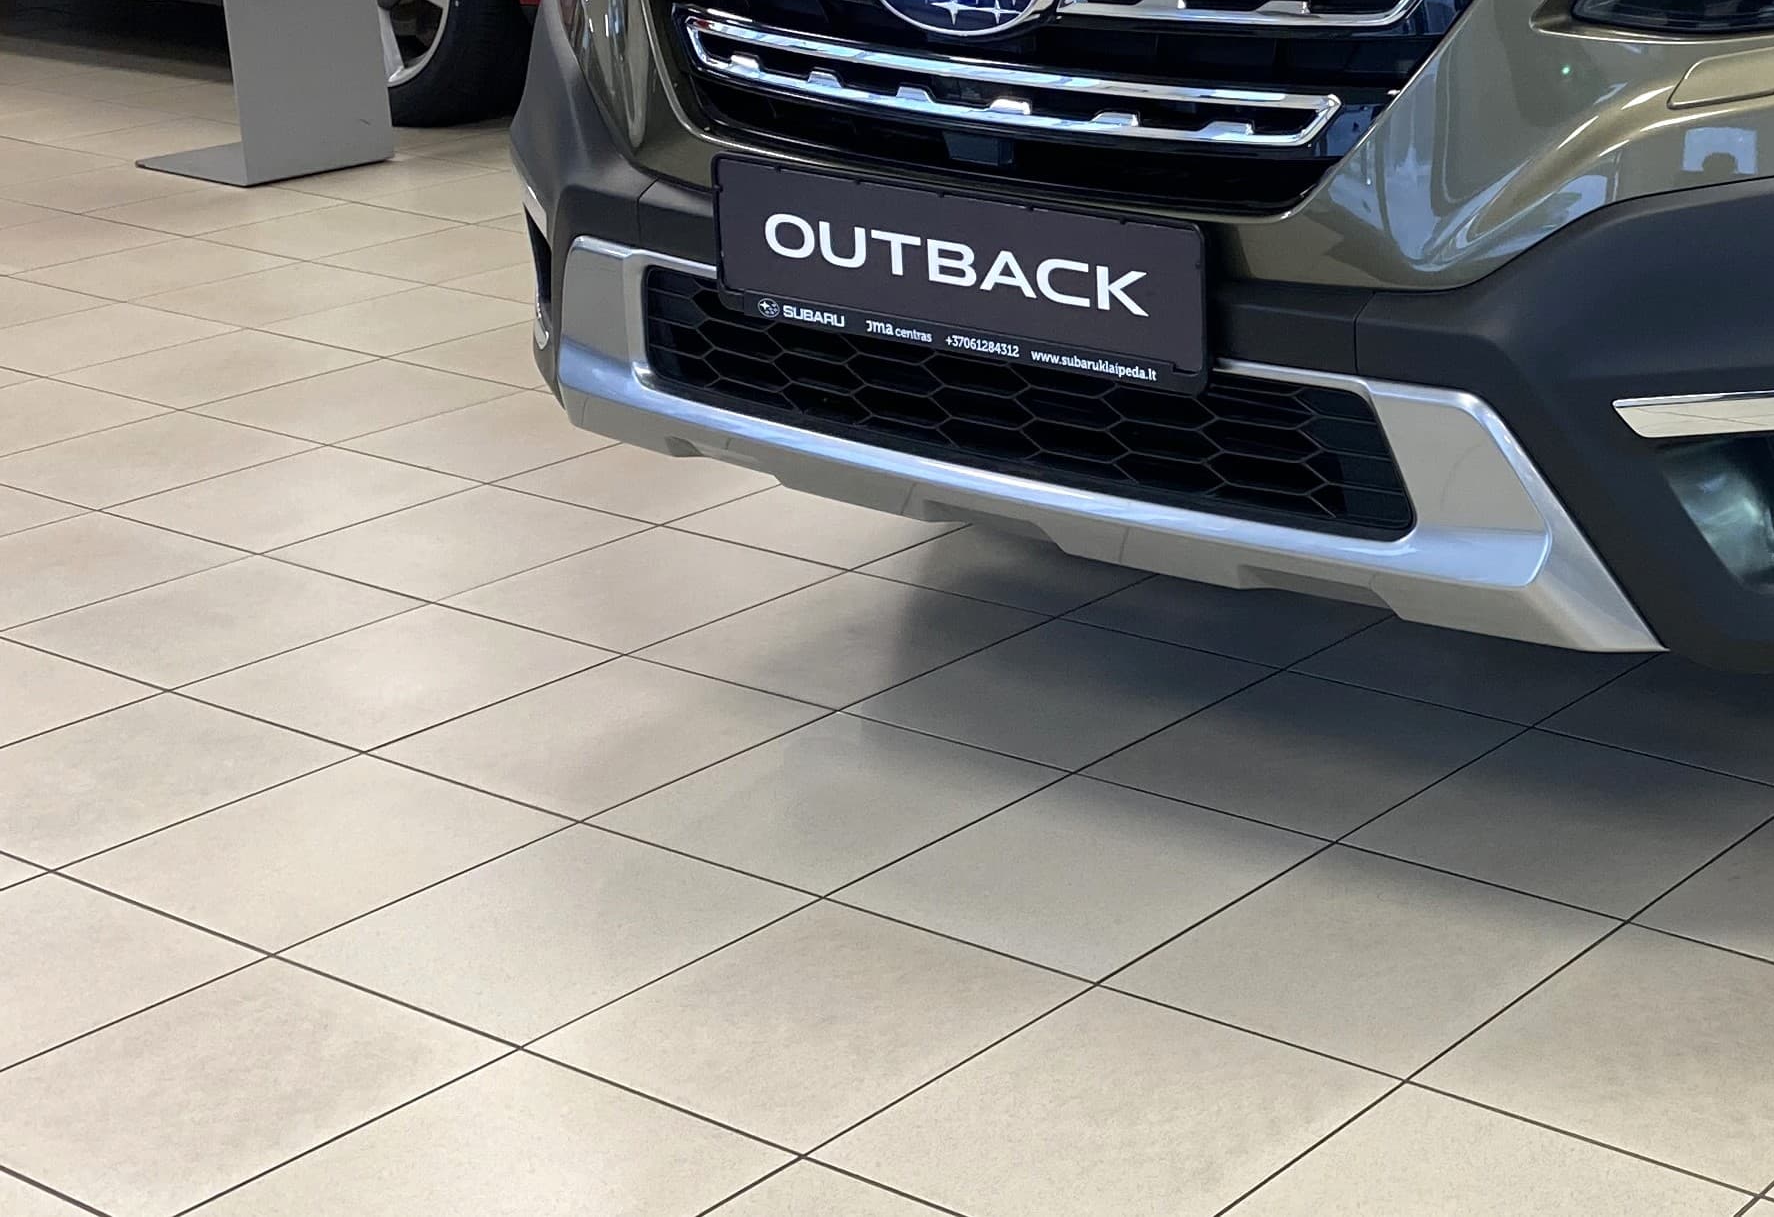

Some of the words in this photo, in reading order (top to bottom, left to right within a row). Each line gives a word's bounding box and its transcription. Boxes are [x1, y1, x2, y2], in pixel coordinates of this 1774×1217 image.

[763, 213, 1149, 317] OUTBACK
[783, 305, 845, 328] SUBARU
[895, 327, 933, 343] centras
[945, 334, 1020, 358] +37061284312
[1030, 350, 1158, 382] www.subaruklaipeda.lt
